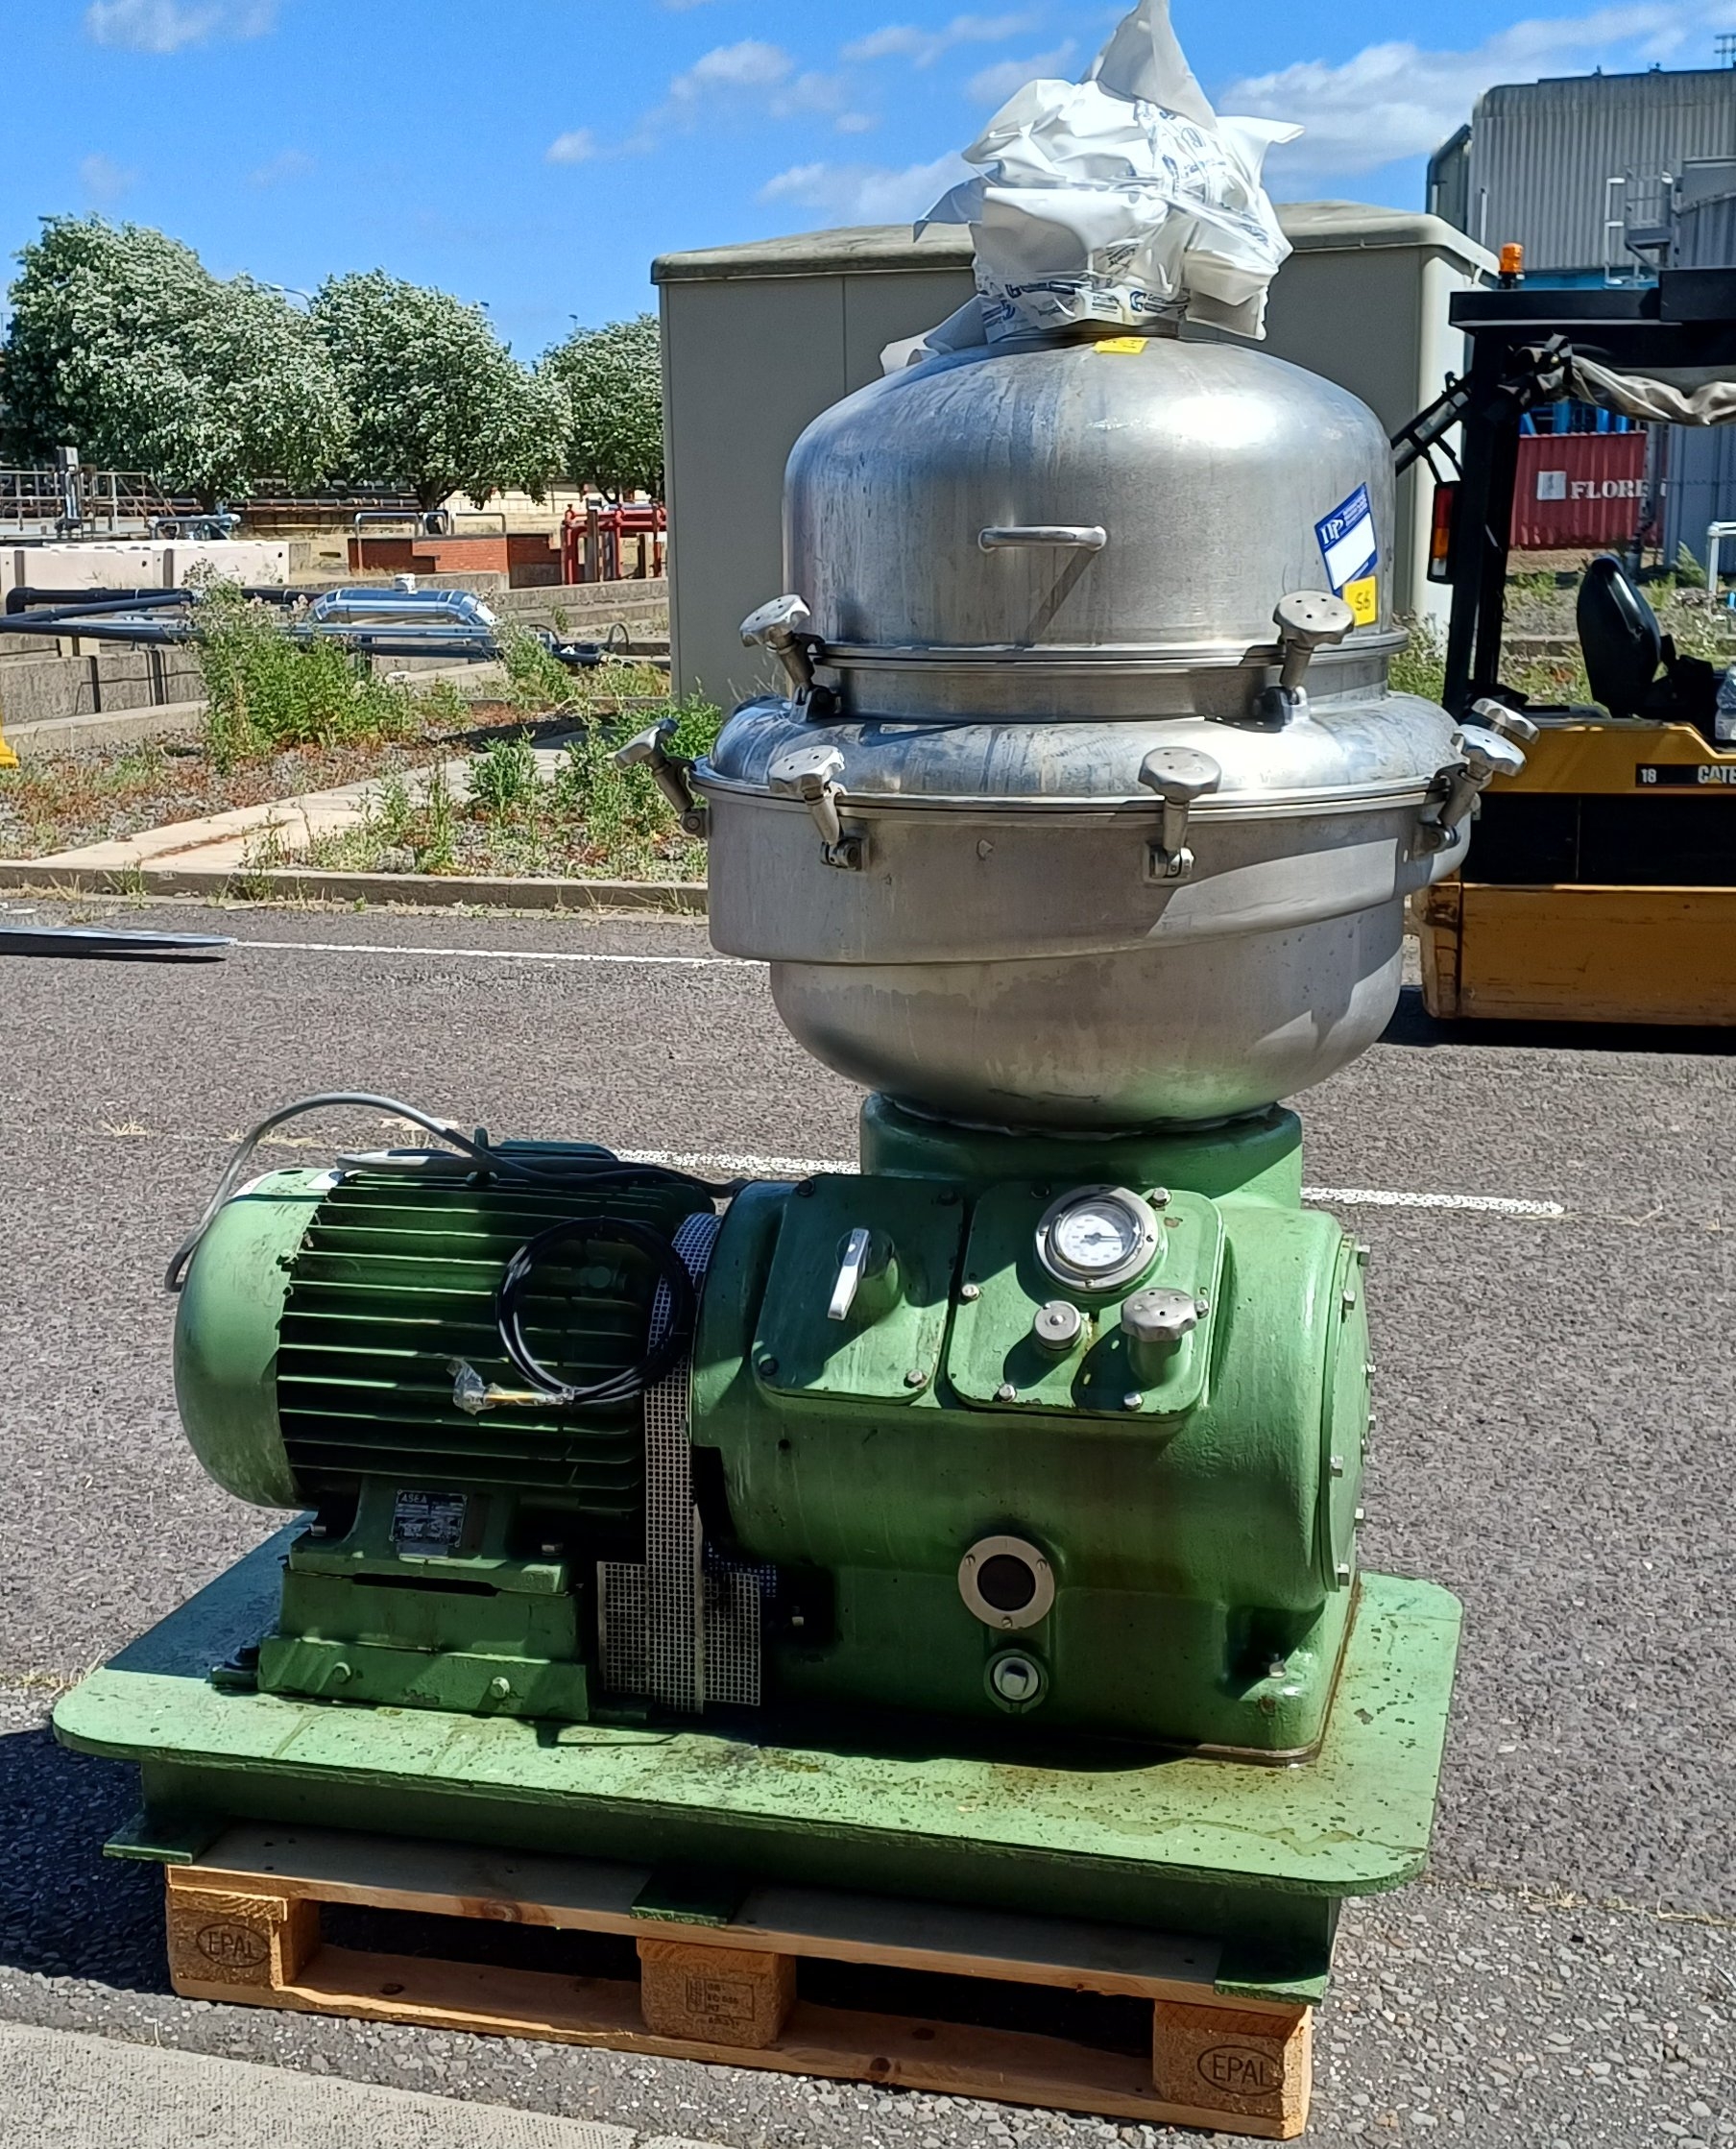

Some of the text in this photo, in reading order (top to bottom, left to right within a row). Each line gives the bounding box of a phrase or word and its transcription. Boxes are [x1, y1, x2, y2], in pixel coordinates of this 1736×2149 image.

[1570, 478, 1667, 500] FLORE
[1641, 767, 1657, 784] 18
[400, 1493, 427, 1504] ASEA
[207, 1930, 260, 1960] EPAL
[1212, 2053, 1278, 2089] EPAL
